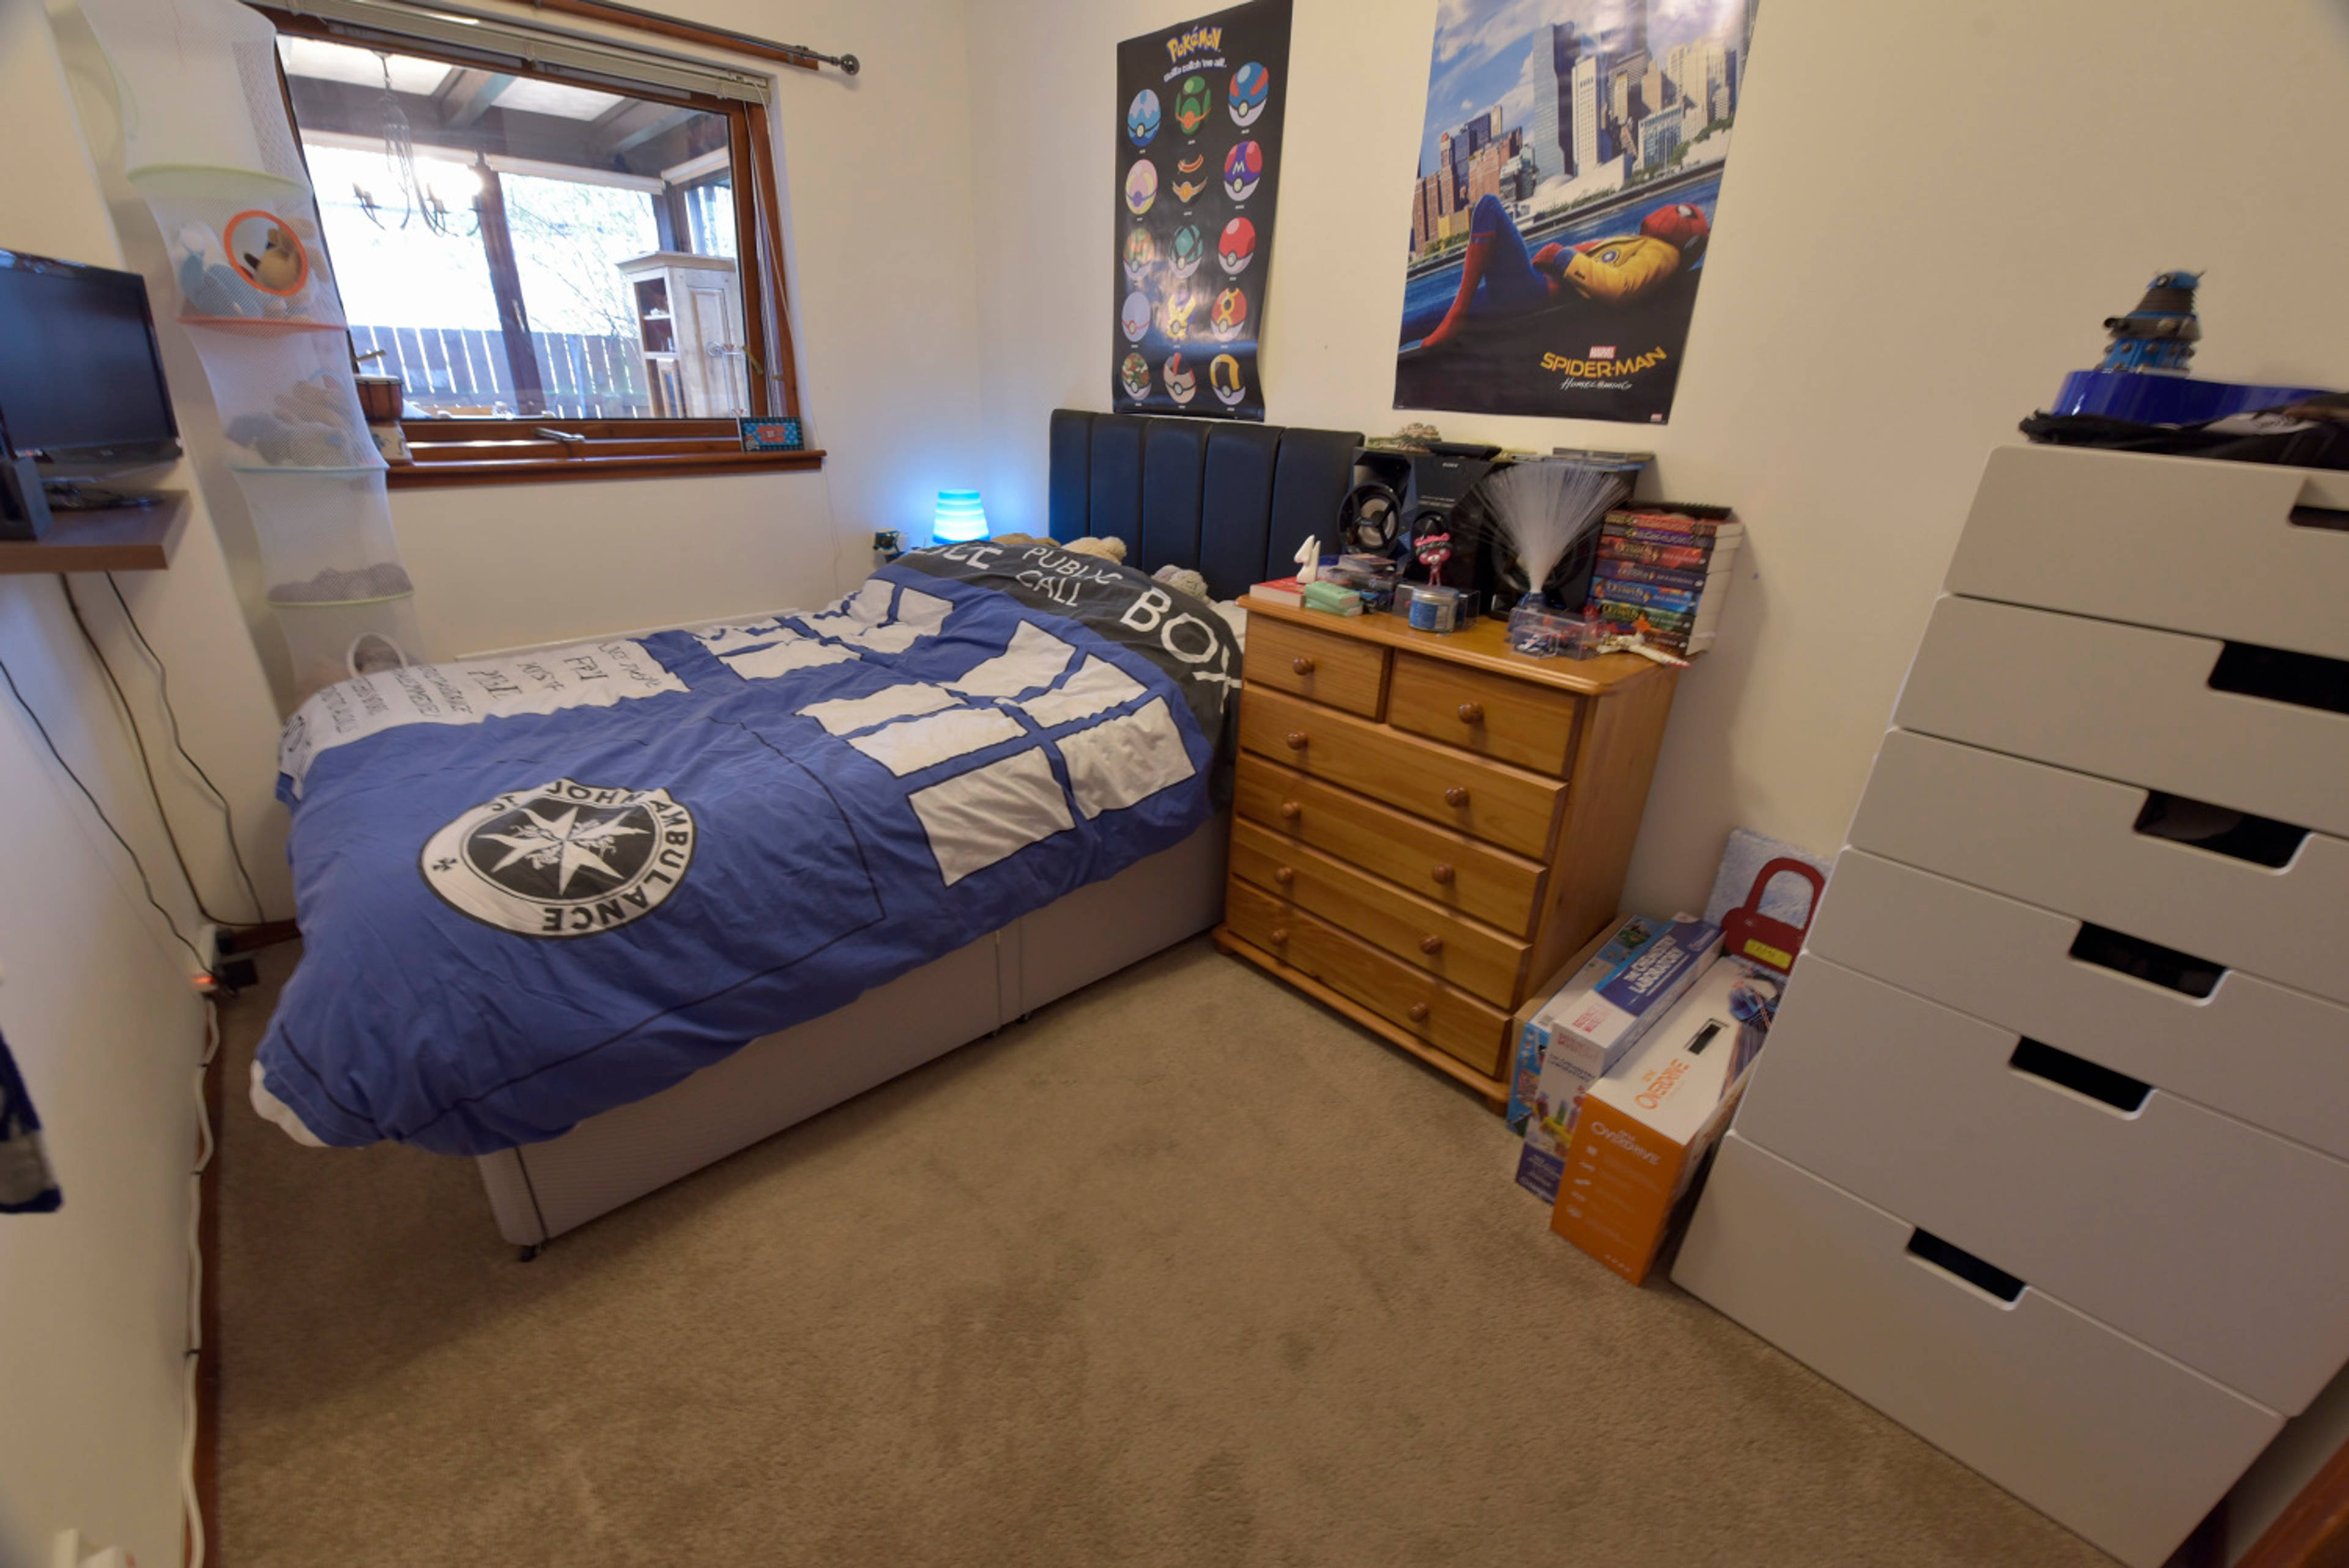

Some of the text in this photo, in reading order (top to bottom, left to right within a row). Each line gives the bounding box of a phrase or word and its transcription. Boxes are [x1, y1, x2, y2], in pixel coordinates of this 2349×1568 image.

[1540, 345, 1667, 378] SPIDER-MAN
[1022, 548, 1123, 585] PUBLIC
[1015, 570, 1082, 607] CALL
[542, 799, 688, 931] AMBULANCE
